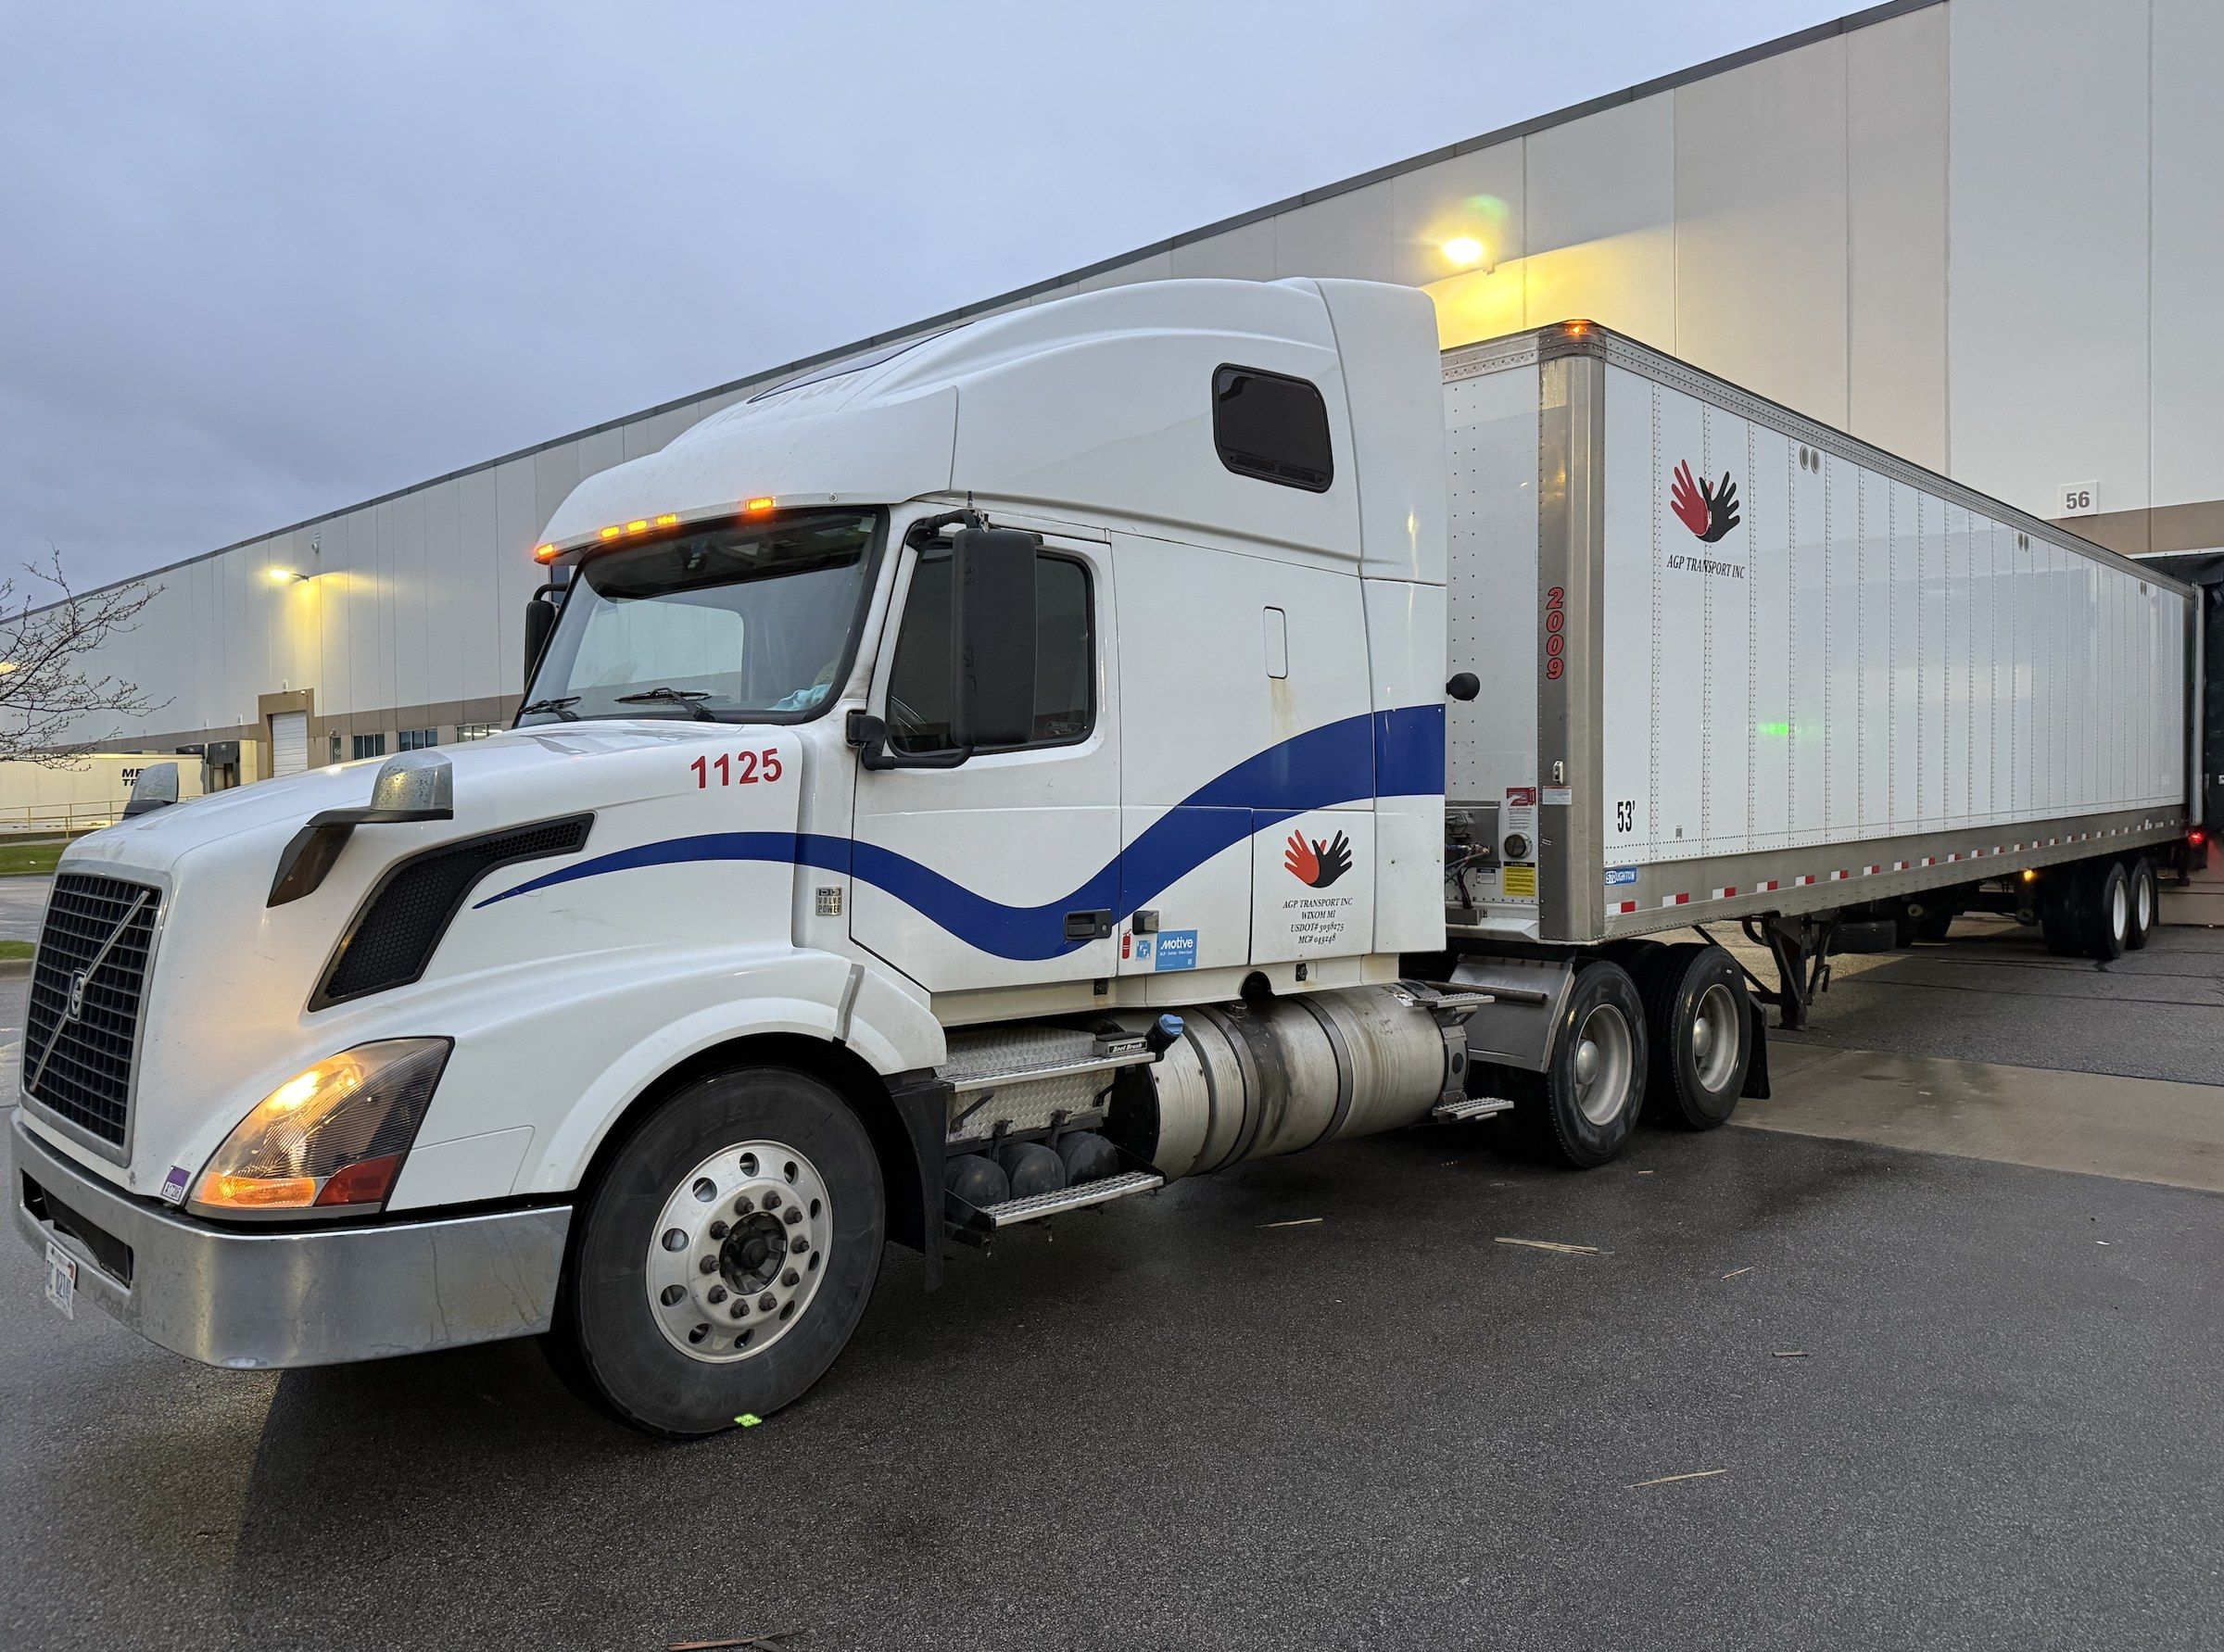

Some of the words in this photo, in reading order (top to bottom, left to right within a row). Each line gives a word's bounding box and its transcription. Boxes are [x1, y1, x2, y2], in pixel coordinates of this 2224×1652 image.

[2066, 491, 2091, 510] 56
[1667, 554, 1685, 569] AGP
[1687, 557, 1732, 576] TRANSPORT
[1732, 564, 1745, 579] INC
[1547, 586, 1564, 679] 2009
[690, 748, 782, 788] 1125
[1617, 801, 1636, 833] 53'
[817, 904, 841, 914] POWER
[1283, 900, 1298, 909] AGP
[1299, 898, 1340, 908] TRANSPORT
[1340, 897, 1354, 906] INC
[1301, 911, 1326, 920] WIXOM
[1326, 910, 1336, 918] MI
[1290, 923, 1319, 933] USDOT#
[1160, 936, 1194, 951] Motive
[1297, 935, 1314, 944] MC#
